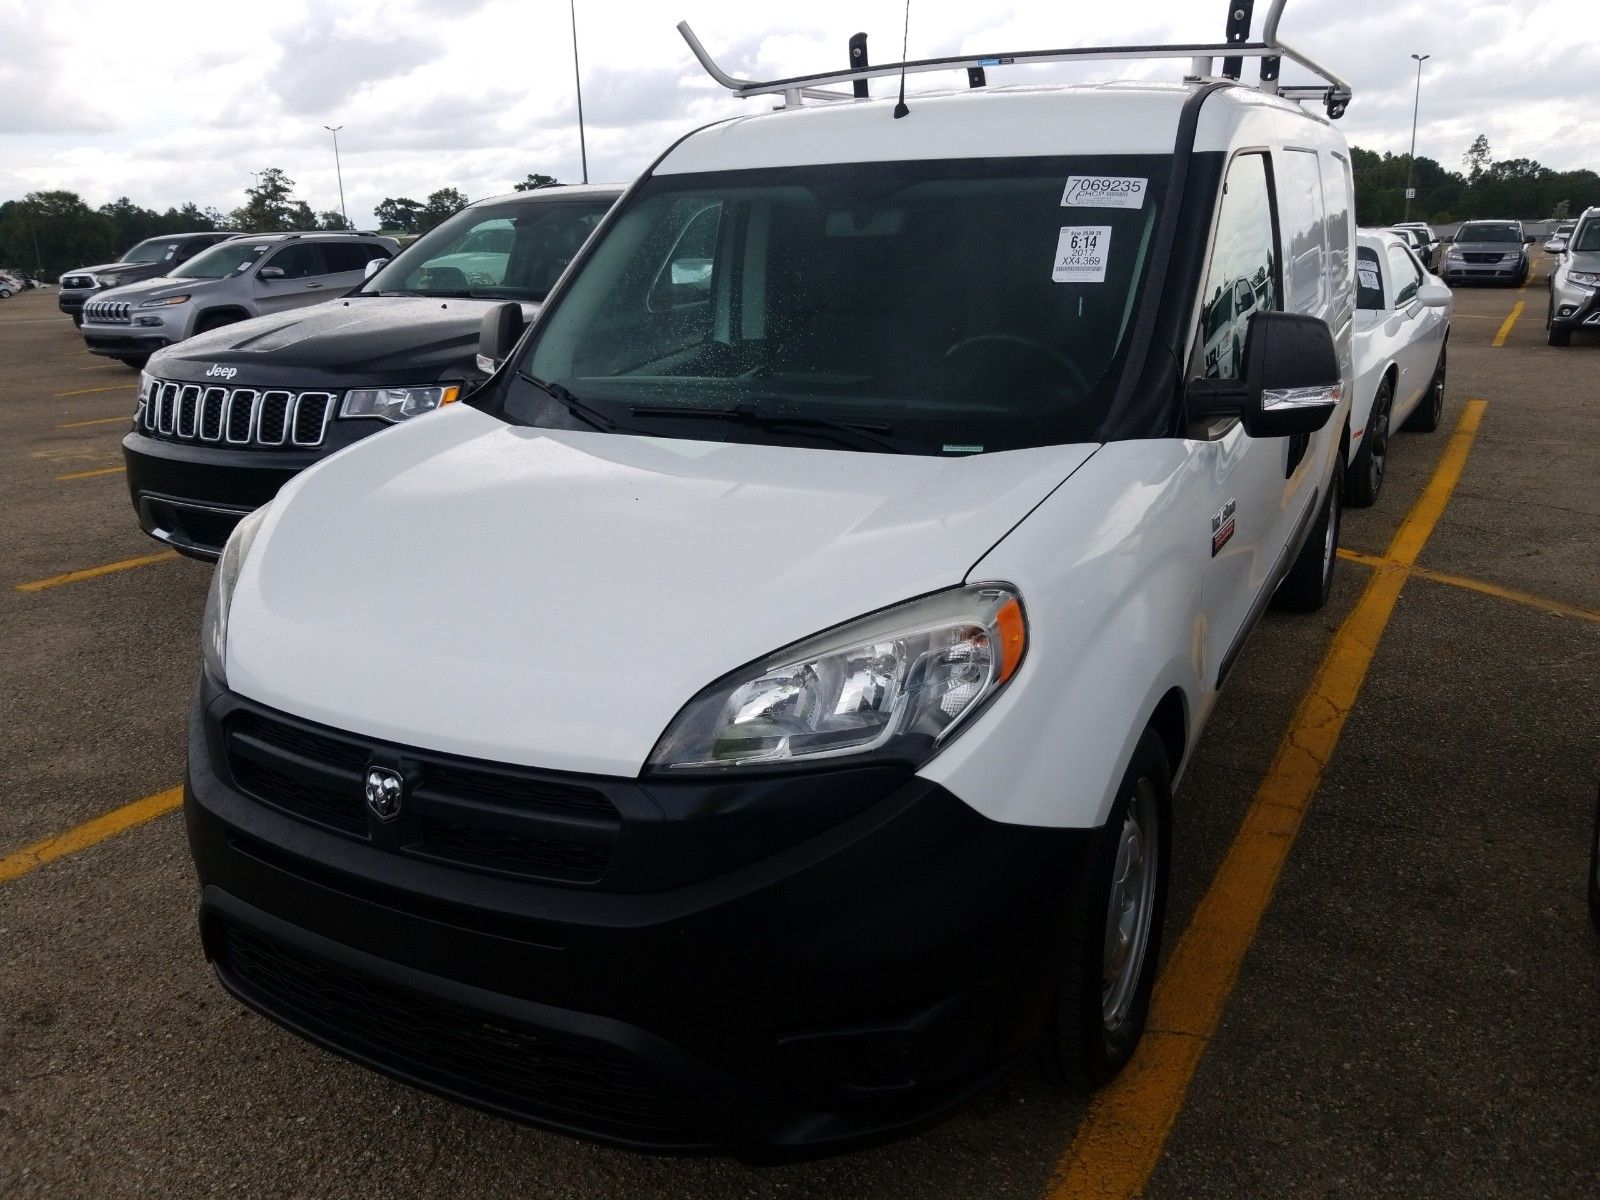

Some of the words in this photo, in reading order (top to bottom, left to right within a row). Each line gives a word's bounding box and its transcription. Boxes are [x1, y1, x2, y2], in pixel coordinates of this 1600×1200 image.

[1066, 178, 1142, 198] 7069235
[1070, 235, 1097, 249] 6:14
[1071, 248, 1095, 257] 2017
[1061, 256, 1101, 266] XX4,369
[205, 363, 238, 380] Jeep
